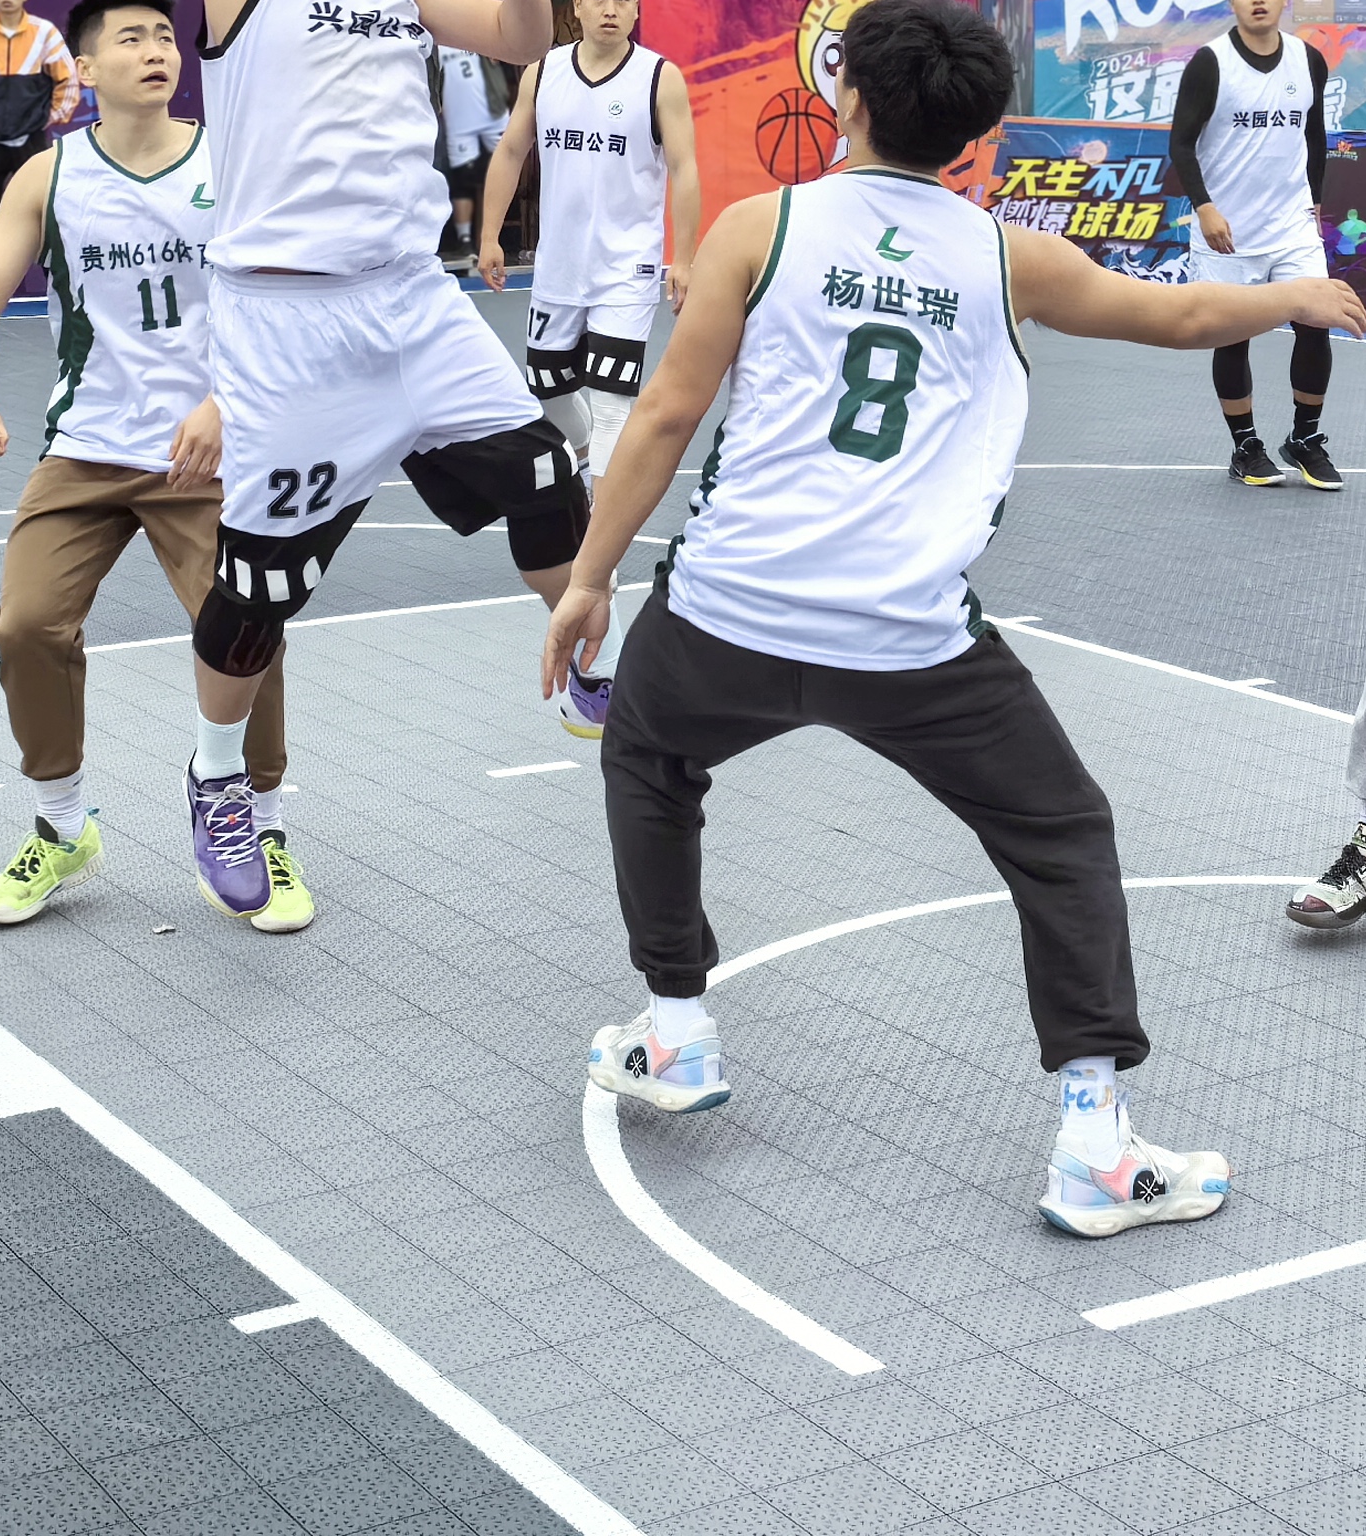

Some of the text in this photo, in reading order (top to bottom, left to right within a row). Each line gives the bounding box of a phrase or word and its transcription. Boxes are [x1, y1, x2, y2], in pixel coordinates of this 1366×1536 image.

[1097, 50, 1146, 78] 2024
[1232, 109, 1302, 128] 兴园公司
[544, 127, 627, 156] 兴园公司
[992, 157, 1164, 201] 天生不凡
[137, 274, 182, 332] 11
[821, 265, 960, 332] 杨世瑞
[527, 306, 552, 341] 17
[828, 321, 924, 464] 8
[266, 459, 338, 520] 22
